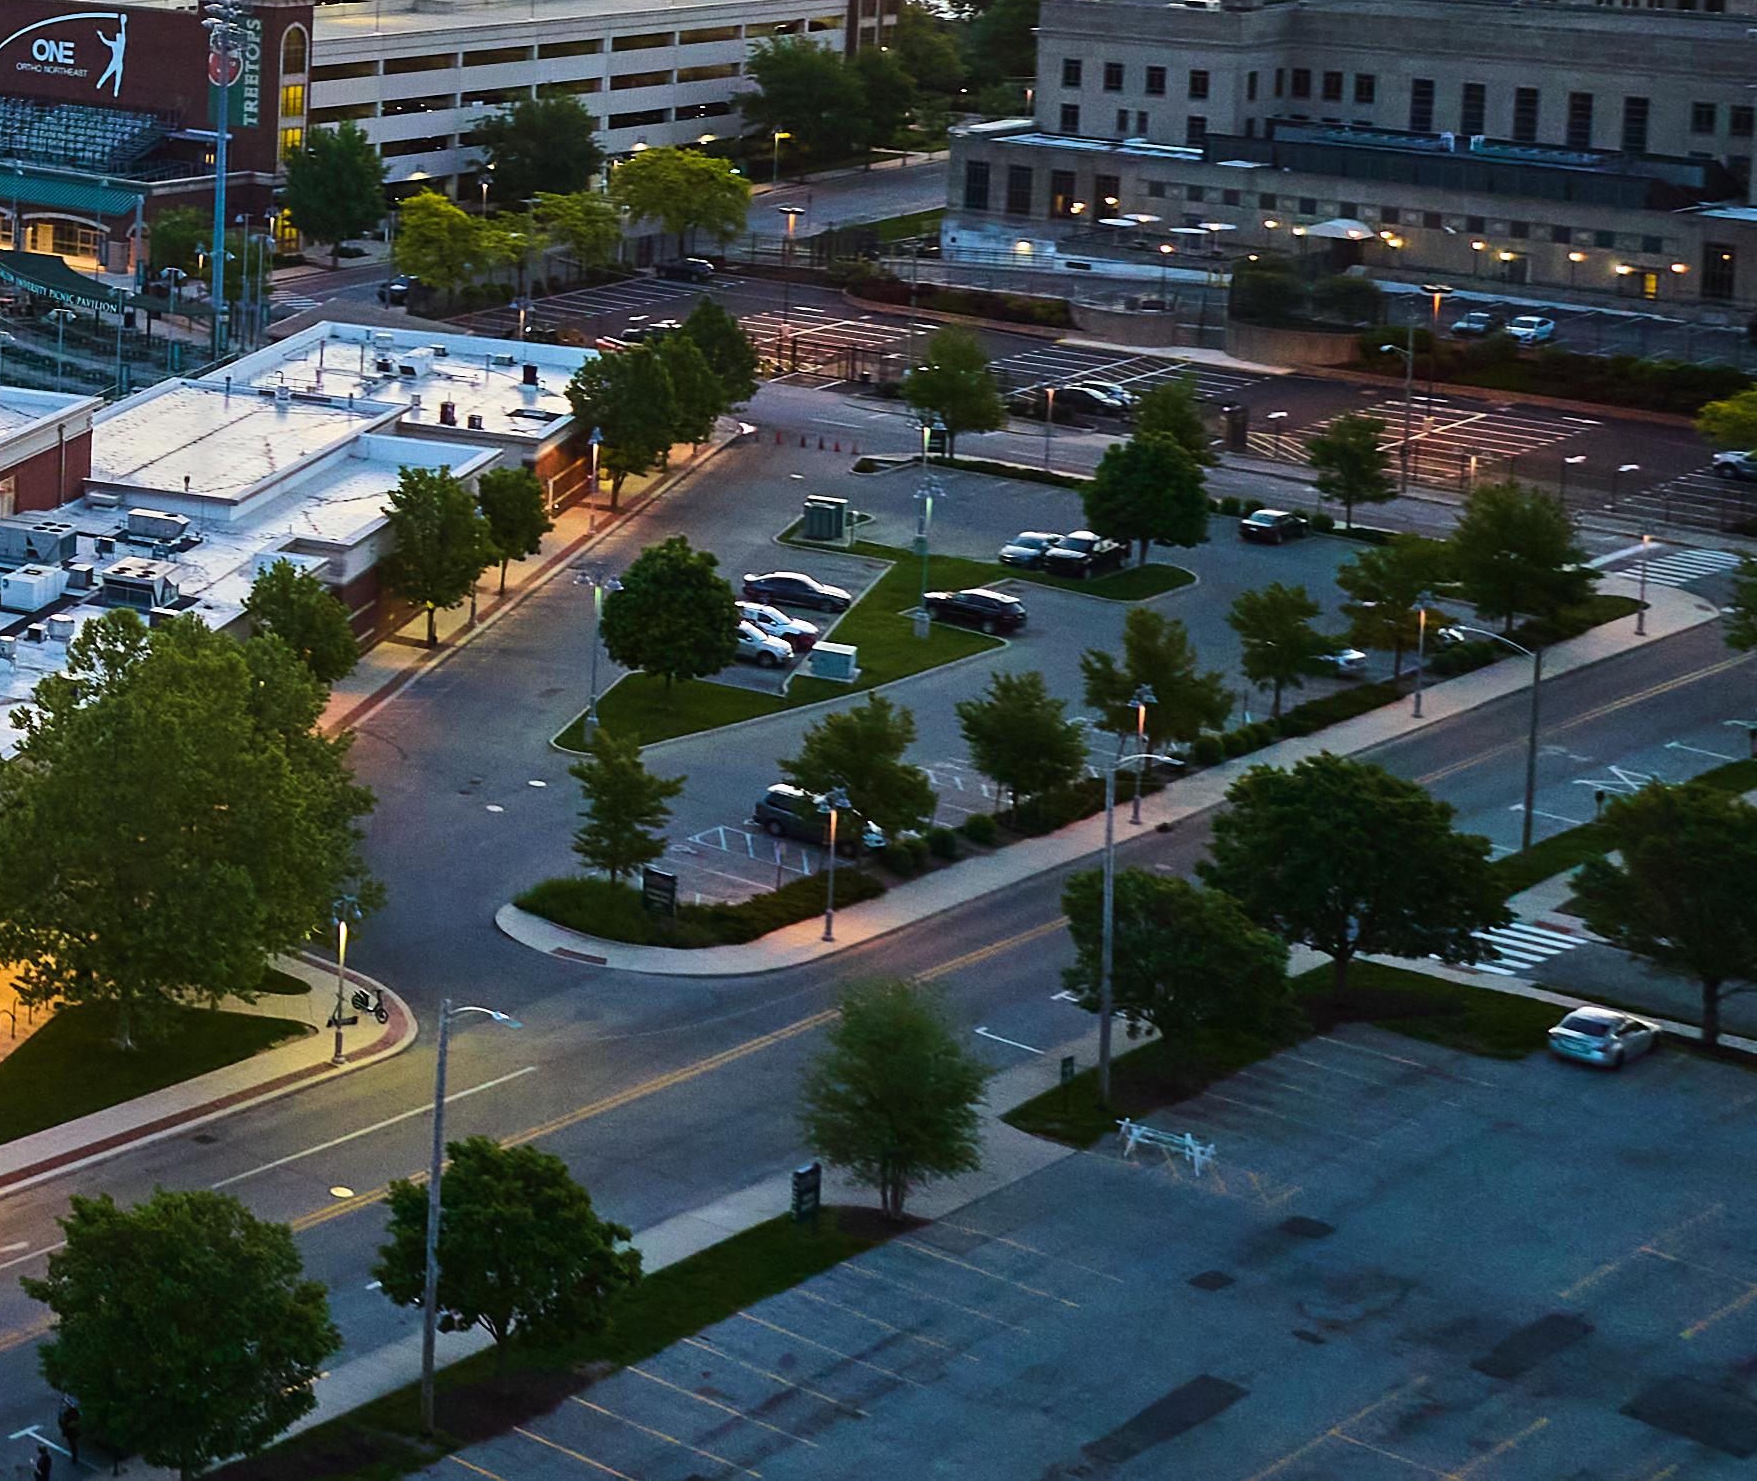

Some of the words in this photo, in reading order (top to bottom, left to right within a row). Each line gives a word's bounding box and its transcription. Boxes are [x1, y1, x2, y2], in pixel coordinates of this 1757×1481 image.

[32, 38, 75, 65] ONE
[16, 62, 42, 73] ORTHO
[44, 64, 89, 78] NORTHEAST
[243, 19, 262, 126] TREETOPS
[16, 277, 47, 296] UNIVERSITY
[49, 288, 74, 305] PICNIC
[77, 296, 118, 313] PAVILION
